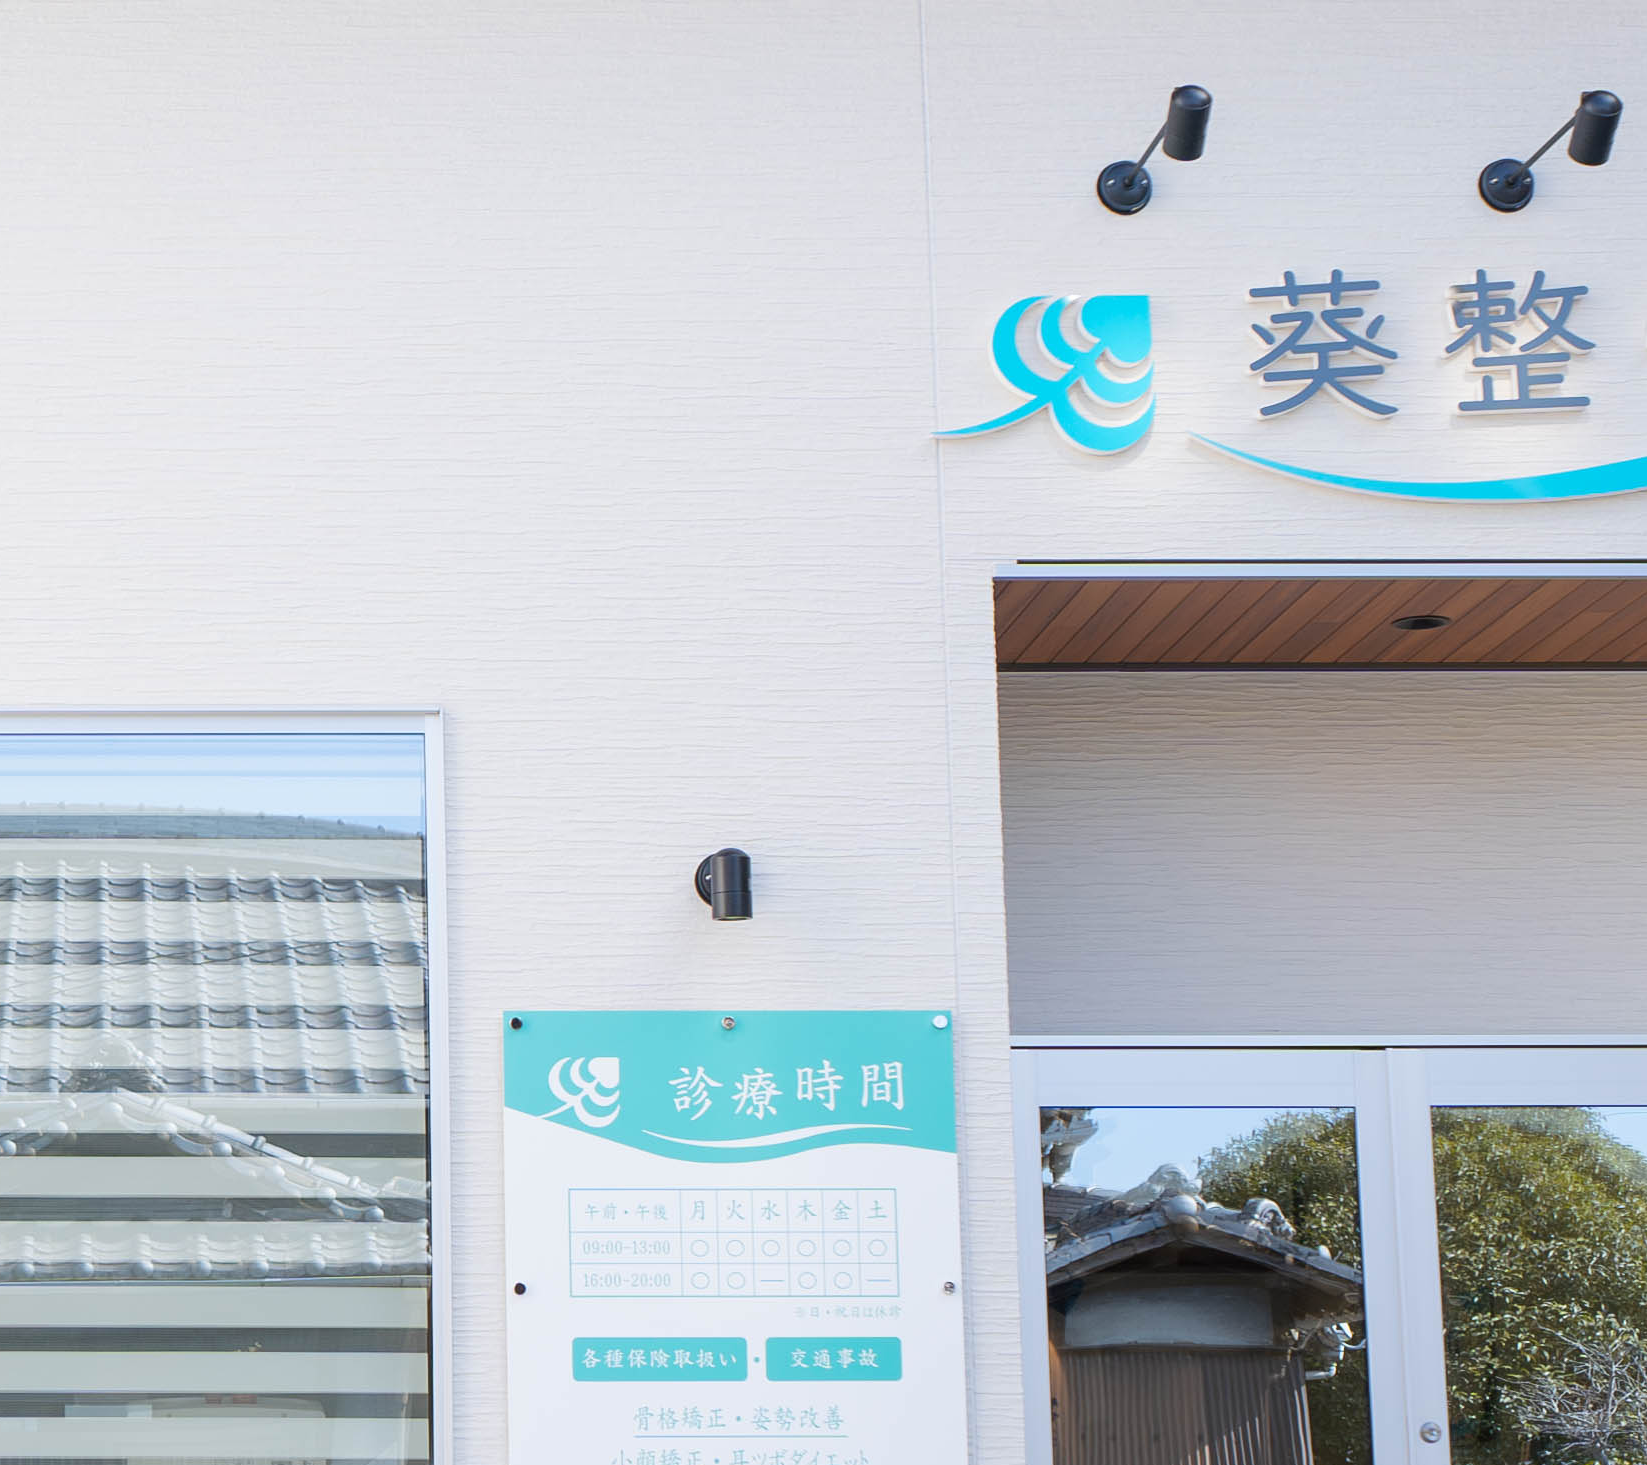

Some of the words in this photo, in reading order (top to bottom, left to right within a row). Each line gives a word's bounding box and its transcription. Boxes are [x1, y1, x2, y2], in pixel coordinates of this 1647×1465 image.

[668, 1059, 905, 1121] 診療時間
[584, 1202, 669, 1221] 午前・午後
[689, 1200, 707, 1222] 月
[726, 1199, 746, 1221] 火
[760, 1199, 782, 1221] 水
[796, 1199, 818, 1221] 木
[832, 1199, 853, 1221] 金
[866, 1199, 889, 1220] 土
[582, 1348, 738, 1369] 各種保険取扱い
[789, 1347, 880, 1369] 交通事故
[633, 1404, 846, 1432] 骨格矯正・姿勢改善
